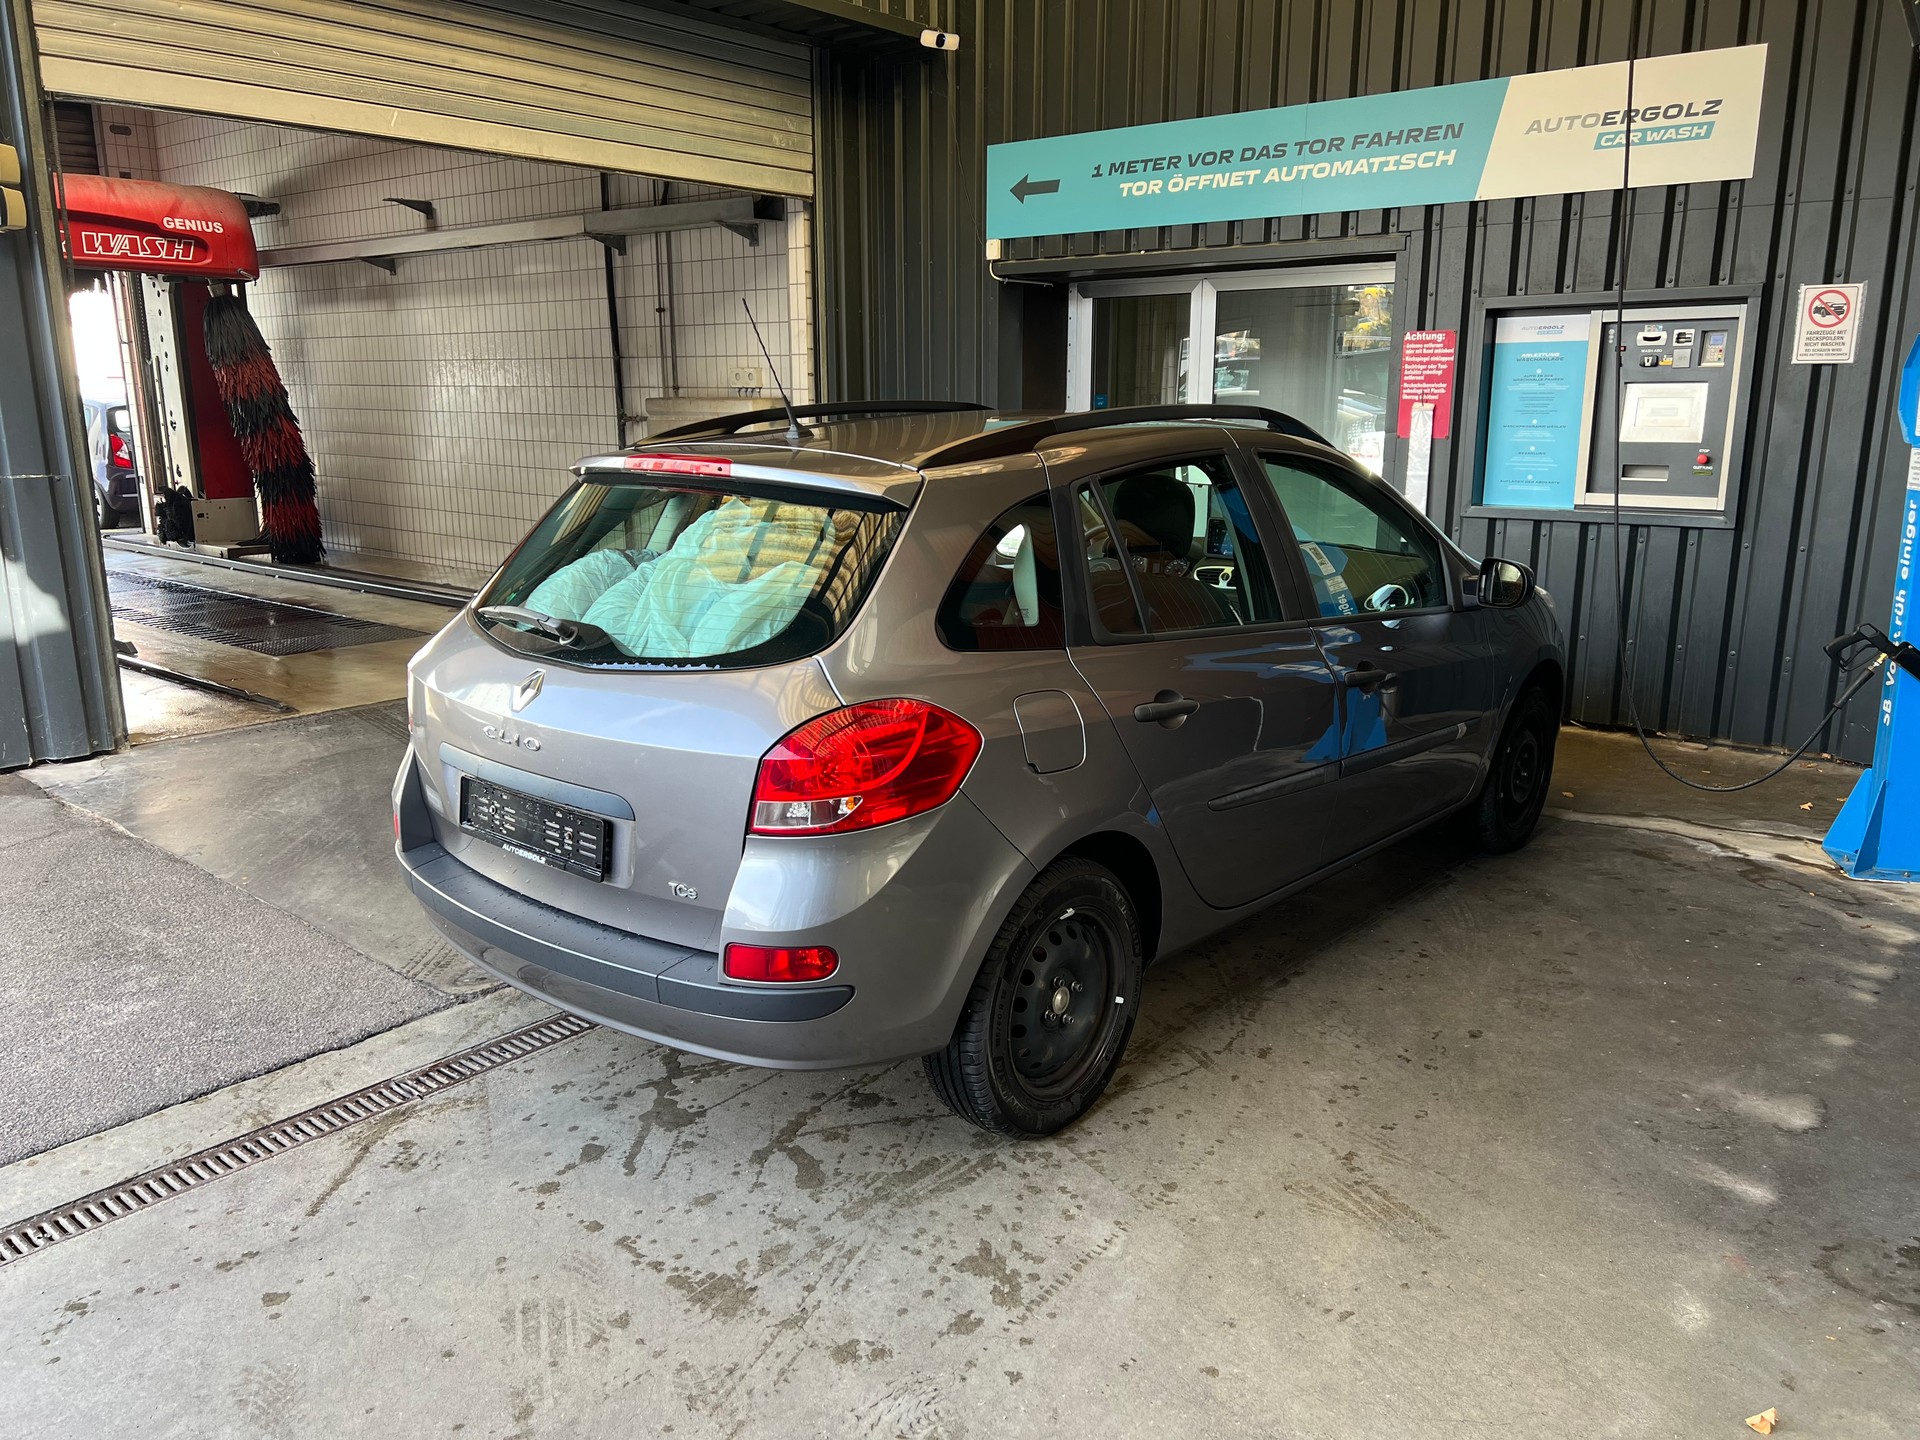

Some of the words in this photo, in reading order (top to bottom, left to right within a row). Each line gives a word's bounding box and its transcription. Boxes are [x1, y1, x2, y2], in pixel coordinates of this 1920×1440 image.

[1524, 99, 1723, 135] AUTOERGOLZ
[1600, 131, 1641, 146] CAR
[1646, 125, 1707, 142] WASH
[1092, 164, 1103, 178] 1
[1108, 155, 1182, 176] METER
[1188, 149, 1234, 167] VOR
[1240, 143, 1288, 162] DAS
[1294, 136, 1346, 156] TOR
[1351, 123, 1464, 150] FAHREN
[1120, 179, 1163, 197] TOR
[1168, 173, 1261, 193] ÖFFNET
[1263, 149, 1457, 184] AUTOMATISCH
[163, 217, 223, 233] GENIUS
[81, 231, 194, 260] WASH
[1405, 332, 1445, 342] Achtung:
[1901, 499, 1918, 580] einiger
[483, 725, 541, 751] CLIO
[502, 843, 546, 864] AUTOERGOLZ
[668, 881, 698, 900] TCe
